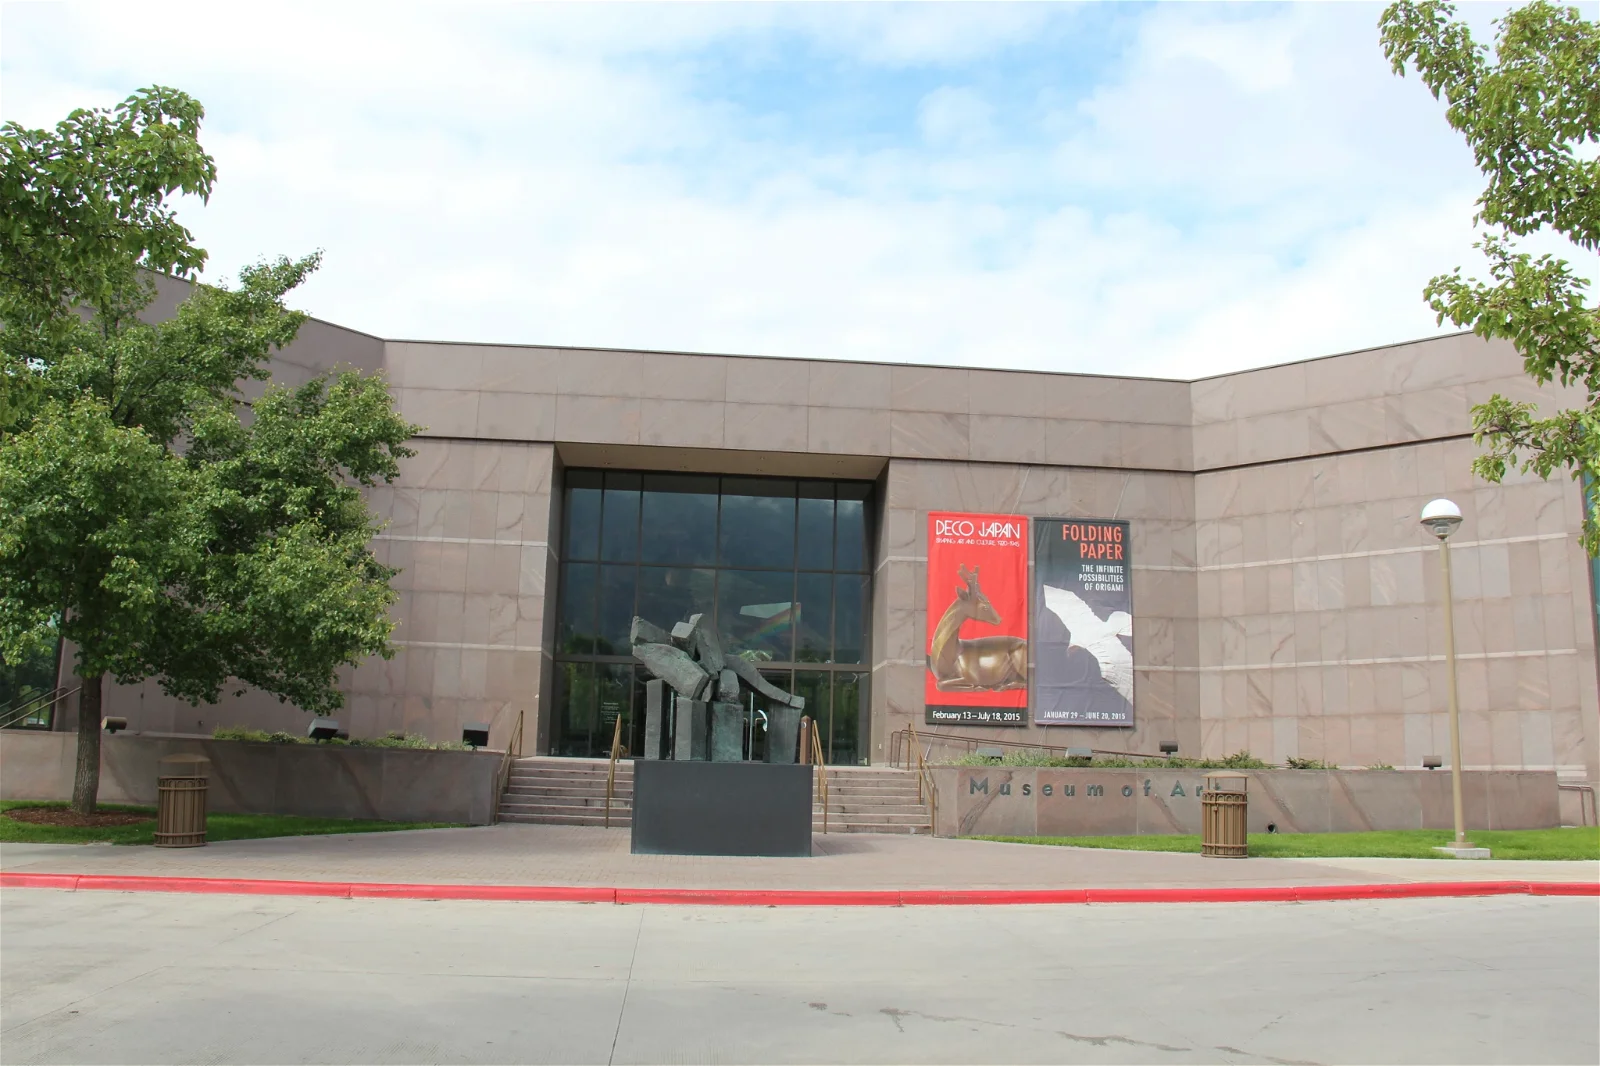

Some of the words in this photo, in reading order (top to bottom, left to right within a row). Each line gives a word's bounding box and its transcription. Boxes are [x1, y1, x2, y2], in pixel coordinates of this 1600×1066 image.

[936, 520, 974, 536] DECO
[978, 522, 1020, 539] JAPAN
[1063, 525, 1122, 542] FOLDING
[1080, 544, 1123, 560] PAPER
[1096, 565, 1123, 573] INFINITE
[1079, 574, 1123, 582] POSSIBILITIES
[1096, 583, 1123, 591] ORIGAMI
[932, 711, 961, 720] February
[992, 712, 1002, 721] 18,
[1003, 713, 1021, 721] 2015
[970, 777, 1104, 797] Museum
[1121, 779, 1151, 797] of
